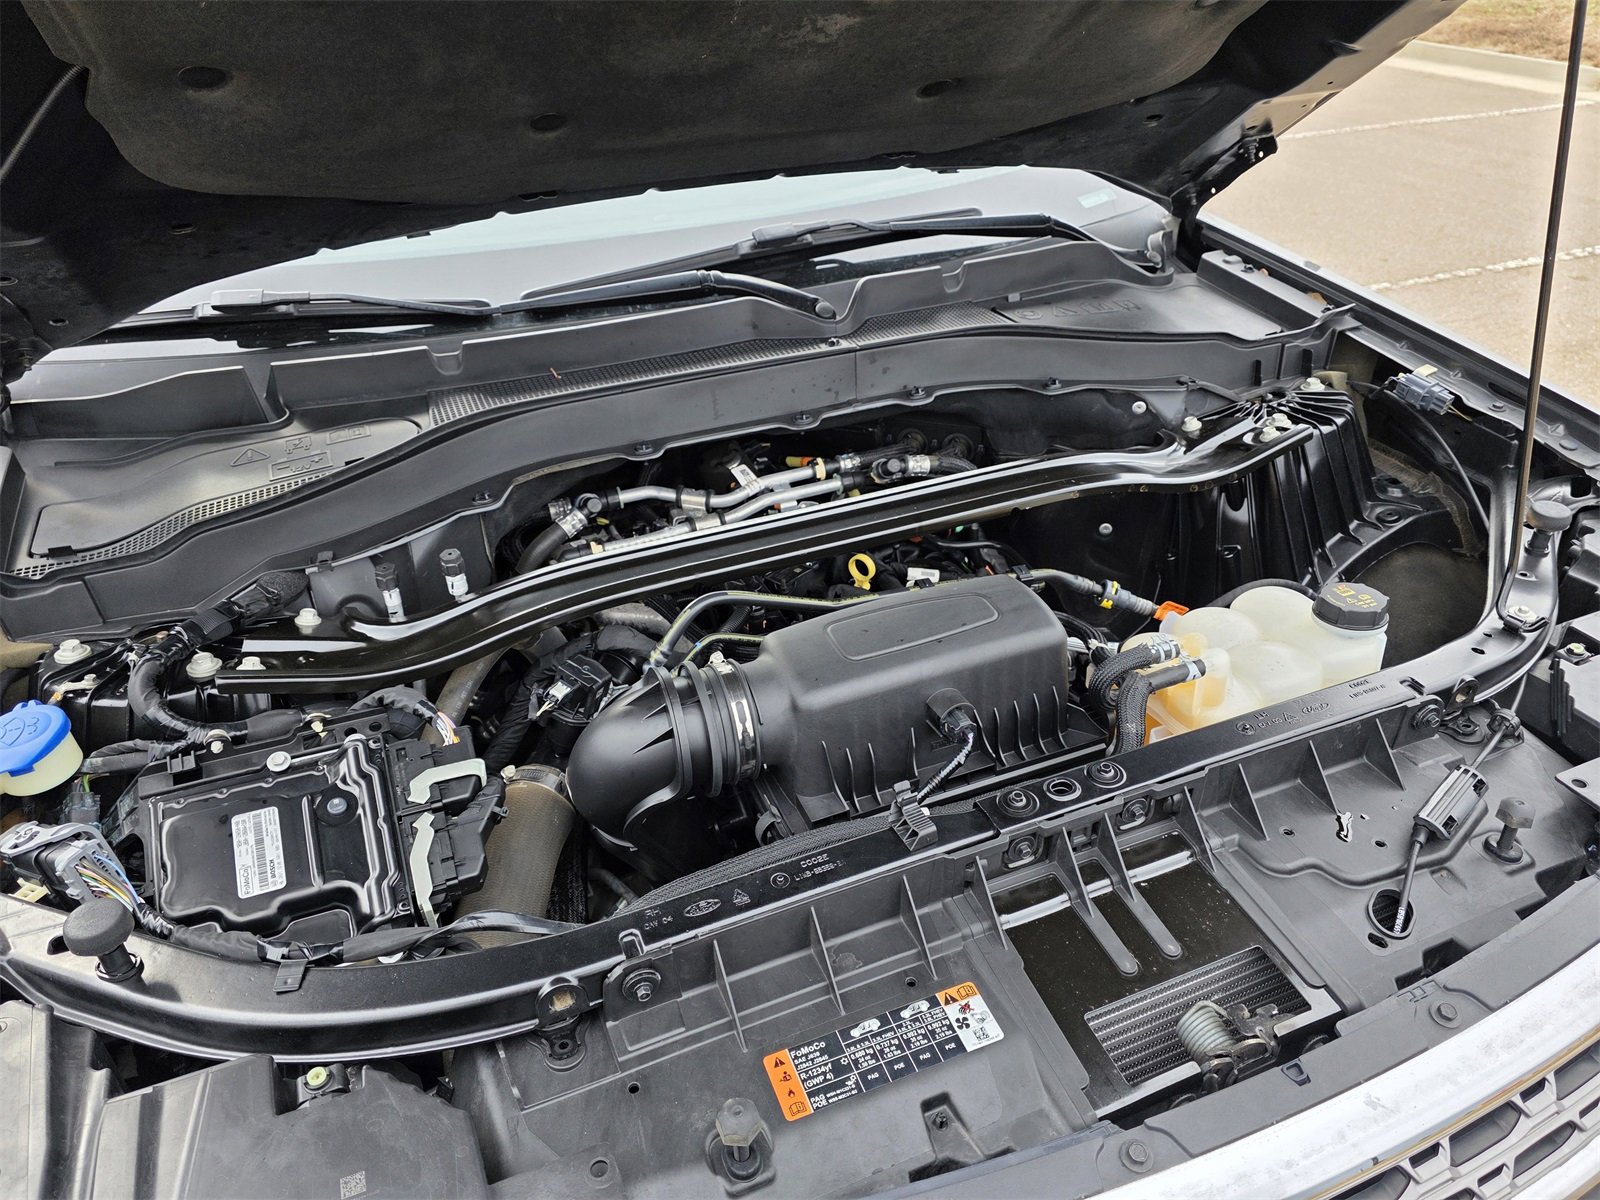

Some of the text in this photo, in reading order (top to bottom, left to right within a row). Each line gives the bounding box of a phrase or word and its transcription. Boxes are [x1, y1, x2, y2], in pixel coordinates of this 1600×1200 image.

[269, 859, 277, 879] BOSCH
[876, 1040, 890, 1050] 0.737
[790, 1042, 826, 1059] FoMoCo
[794, 1056, 806, 1064] SAE
[919, 1052, 931, 1060] PAG
[894, 1062, 905, 1070] POE
[800, 1063, 832, 1080] R-1234yf
[867, 1072, 879, 1080] PAG
[804, 1072, 834, 1089] (GWP 4)
[810, 1094, 825, 1104] PAG
[813, 1099, 828, 1109] POE
